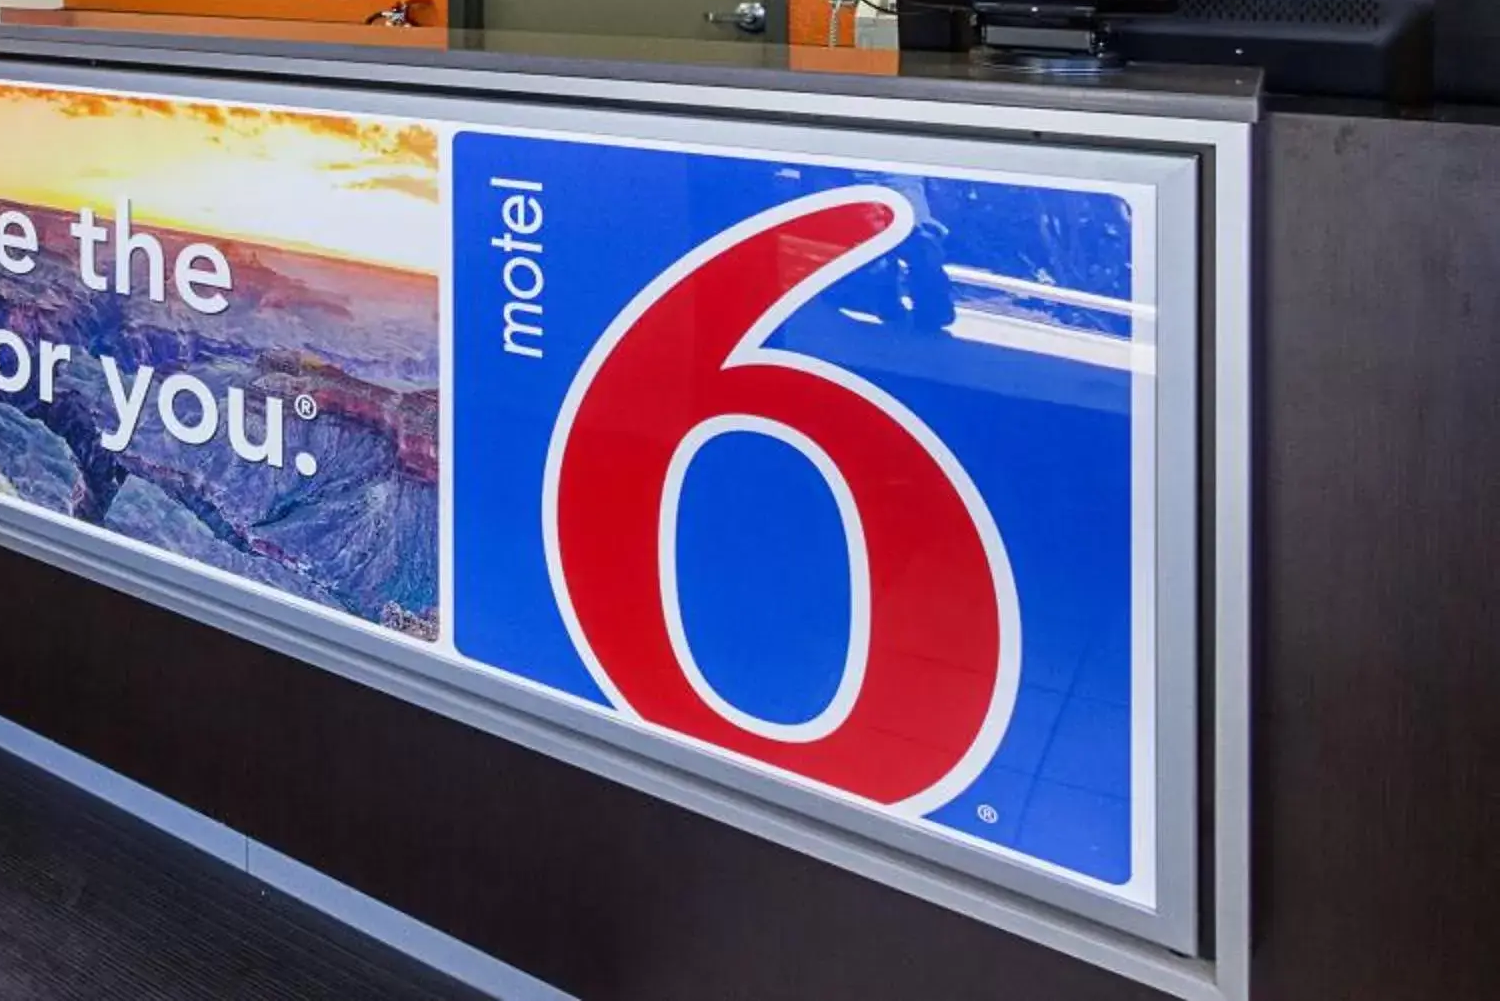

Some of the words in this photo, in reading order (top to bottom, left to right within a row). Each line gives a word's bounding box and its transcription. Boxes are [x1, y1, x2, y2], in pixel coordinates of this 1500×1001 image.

[70, 197, 233, 315] the
[490, 177, 544, 359] motel
[542, 183, 1022, 819] 6
